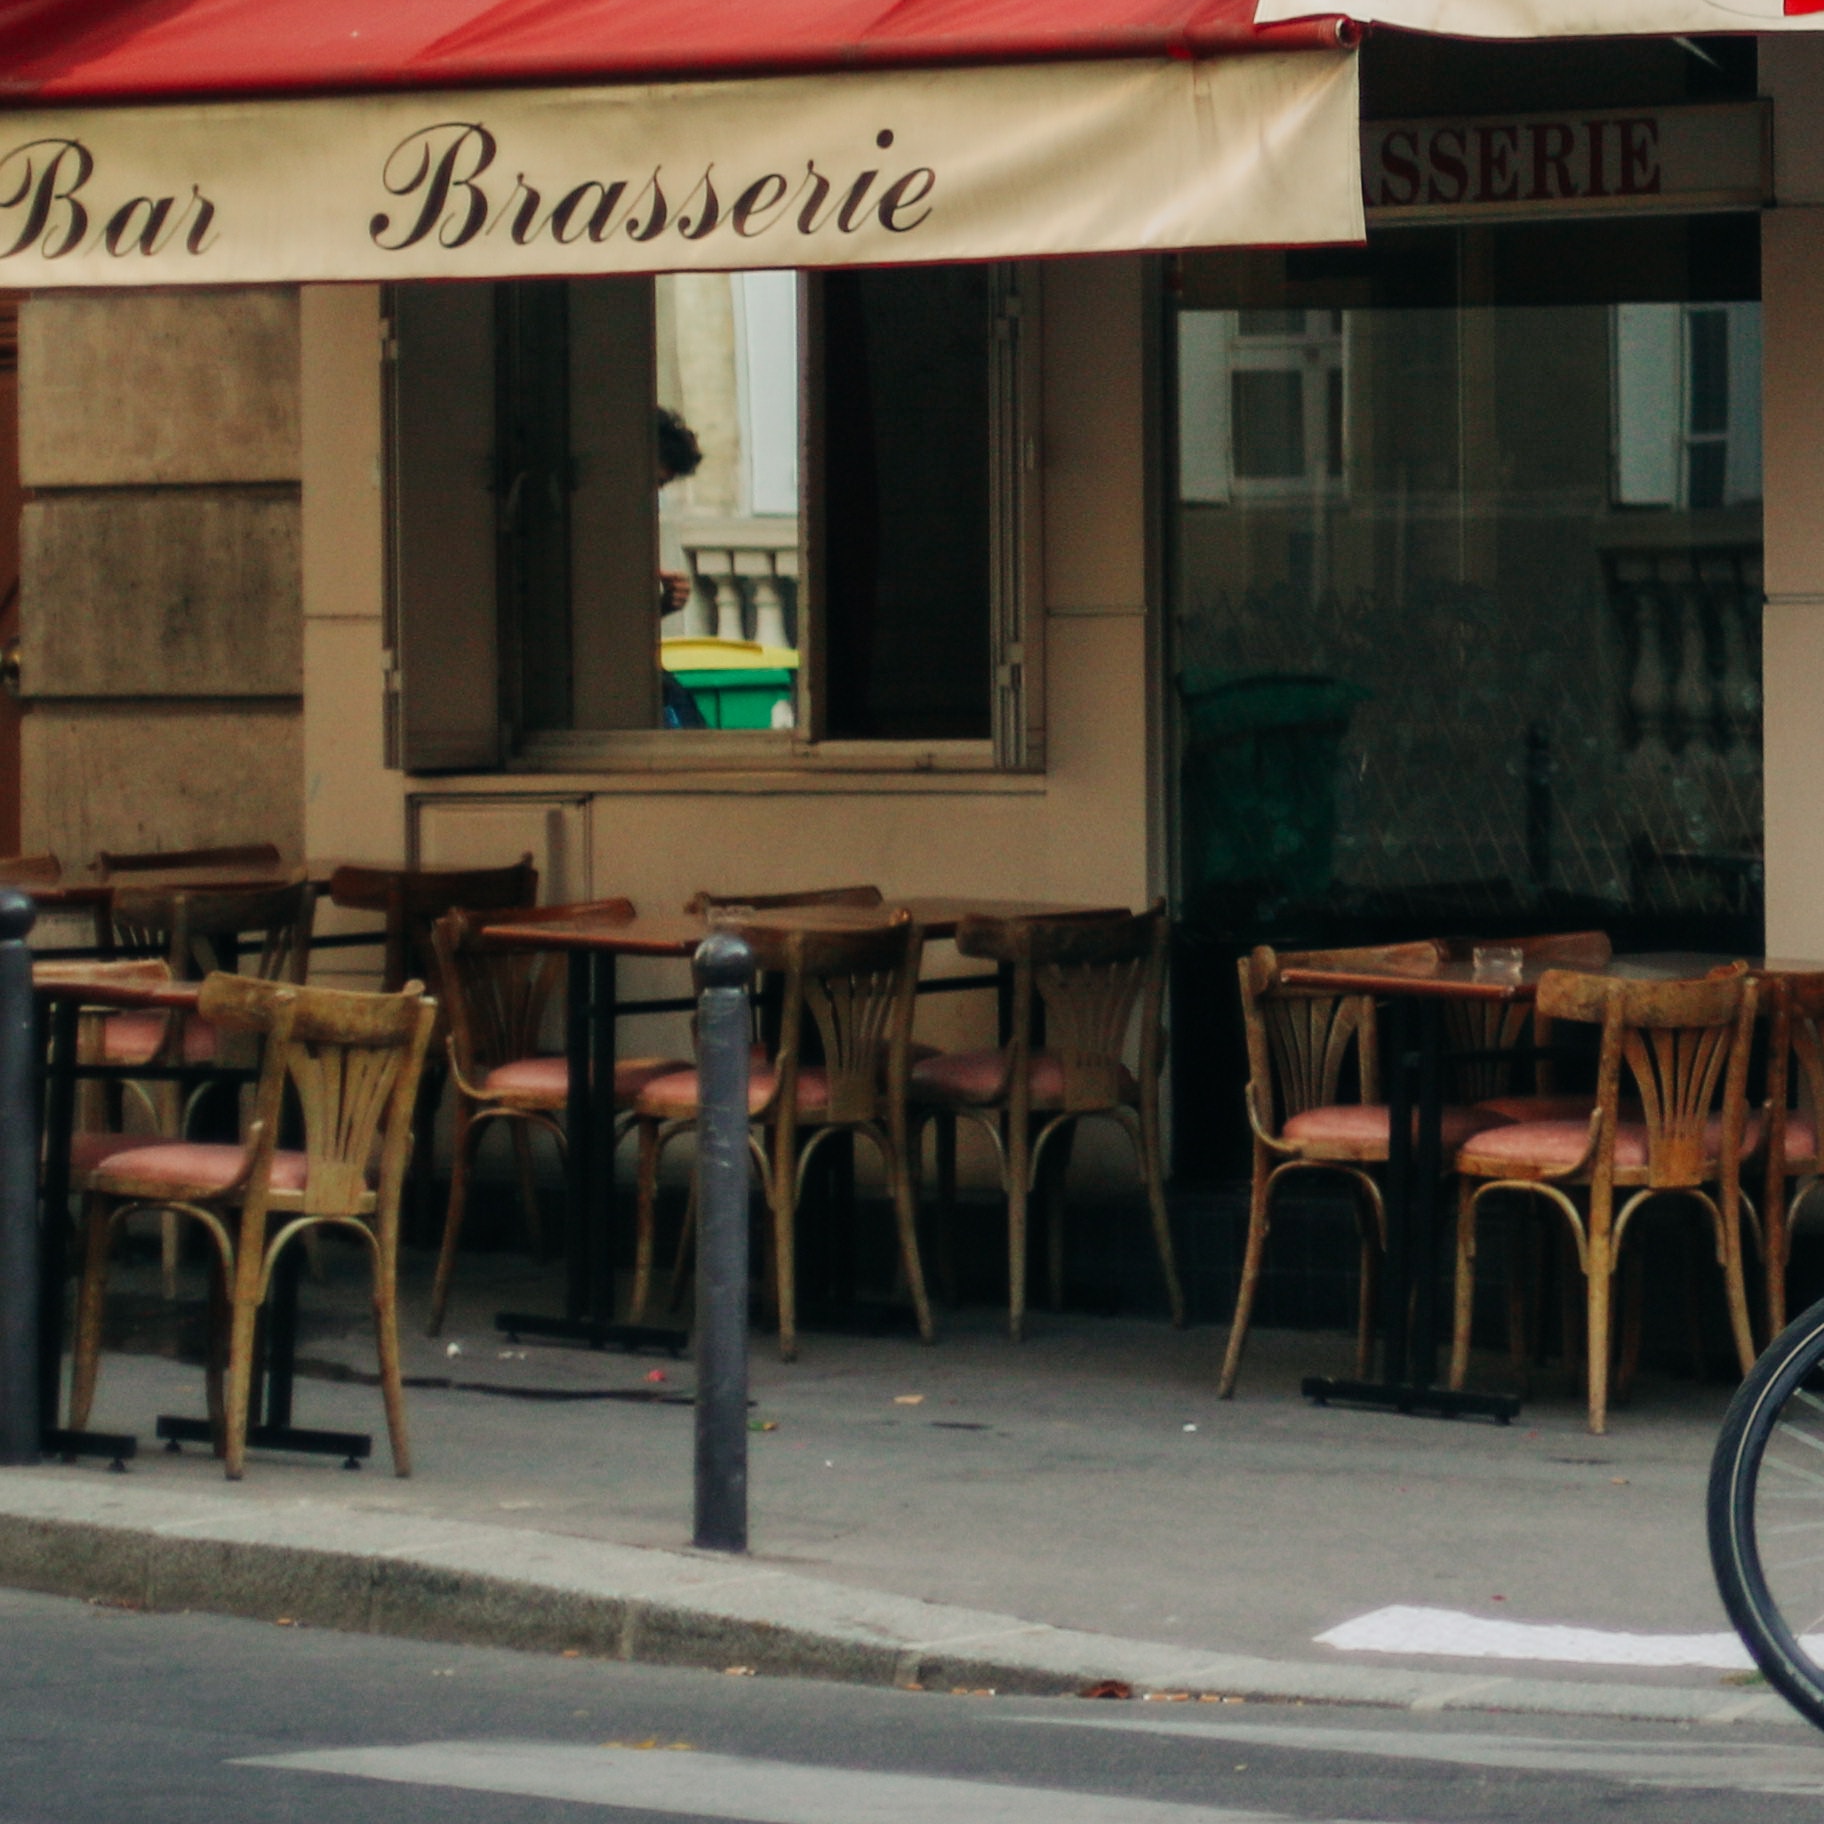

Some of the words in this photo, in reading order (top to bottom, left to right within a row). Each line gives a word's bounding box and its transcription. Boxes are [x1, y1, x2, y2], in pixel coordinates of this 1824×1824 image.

[0, 139, 220, 259] Bar
[369, 121, 936, 250] Brasserie
[1362, 119, 1661, 205] SSERIE
